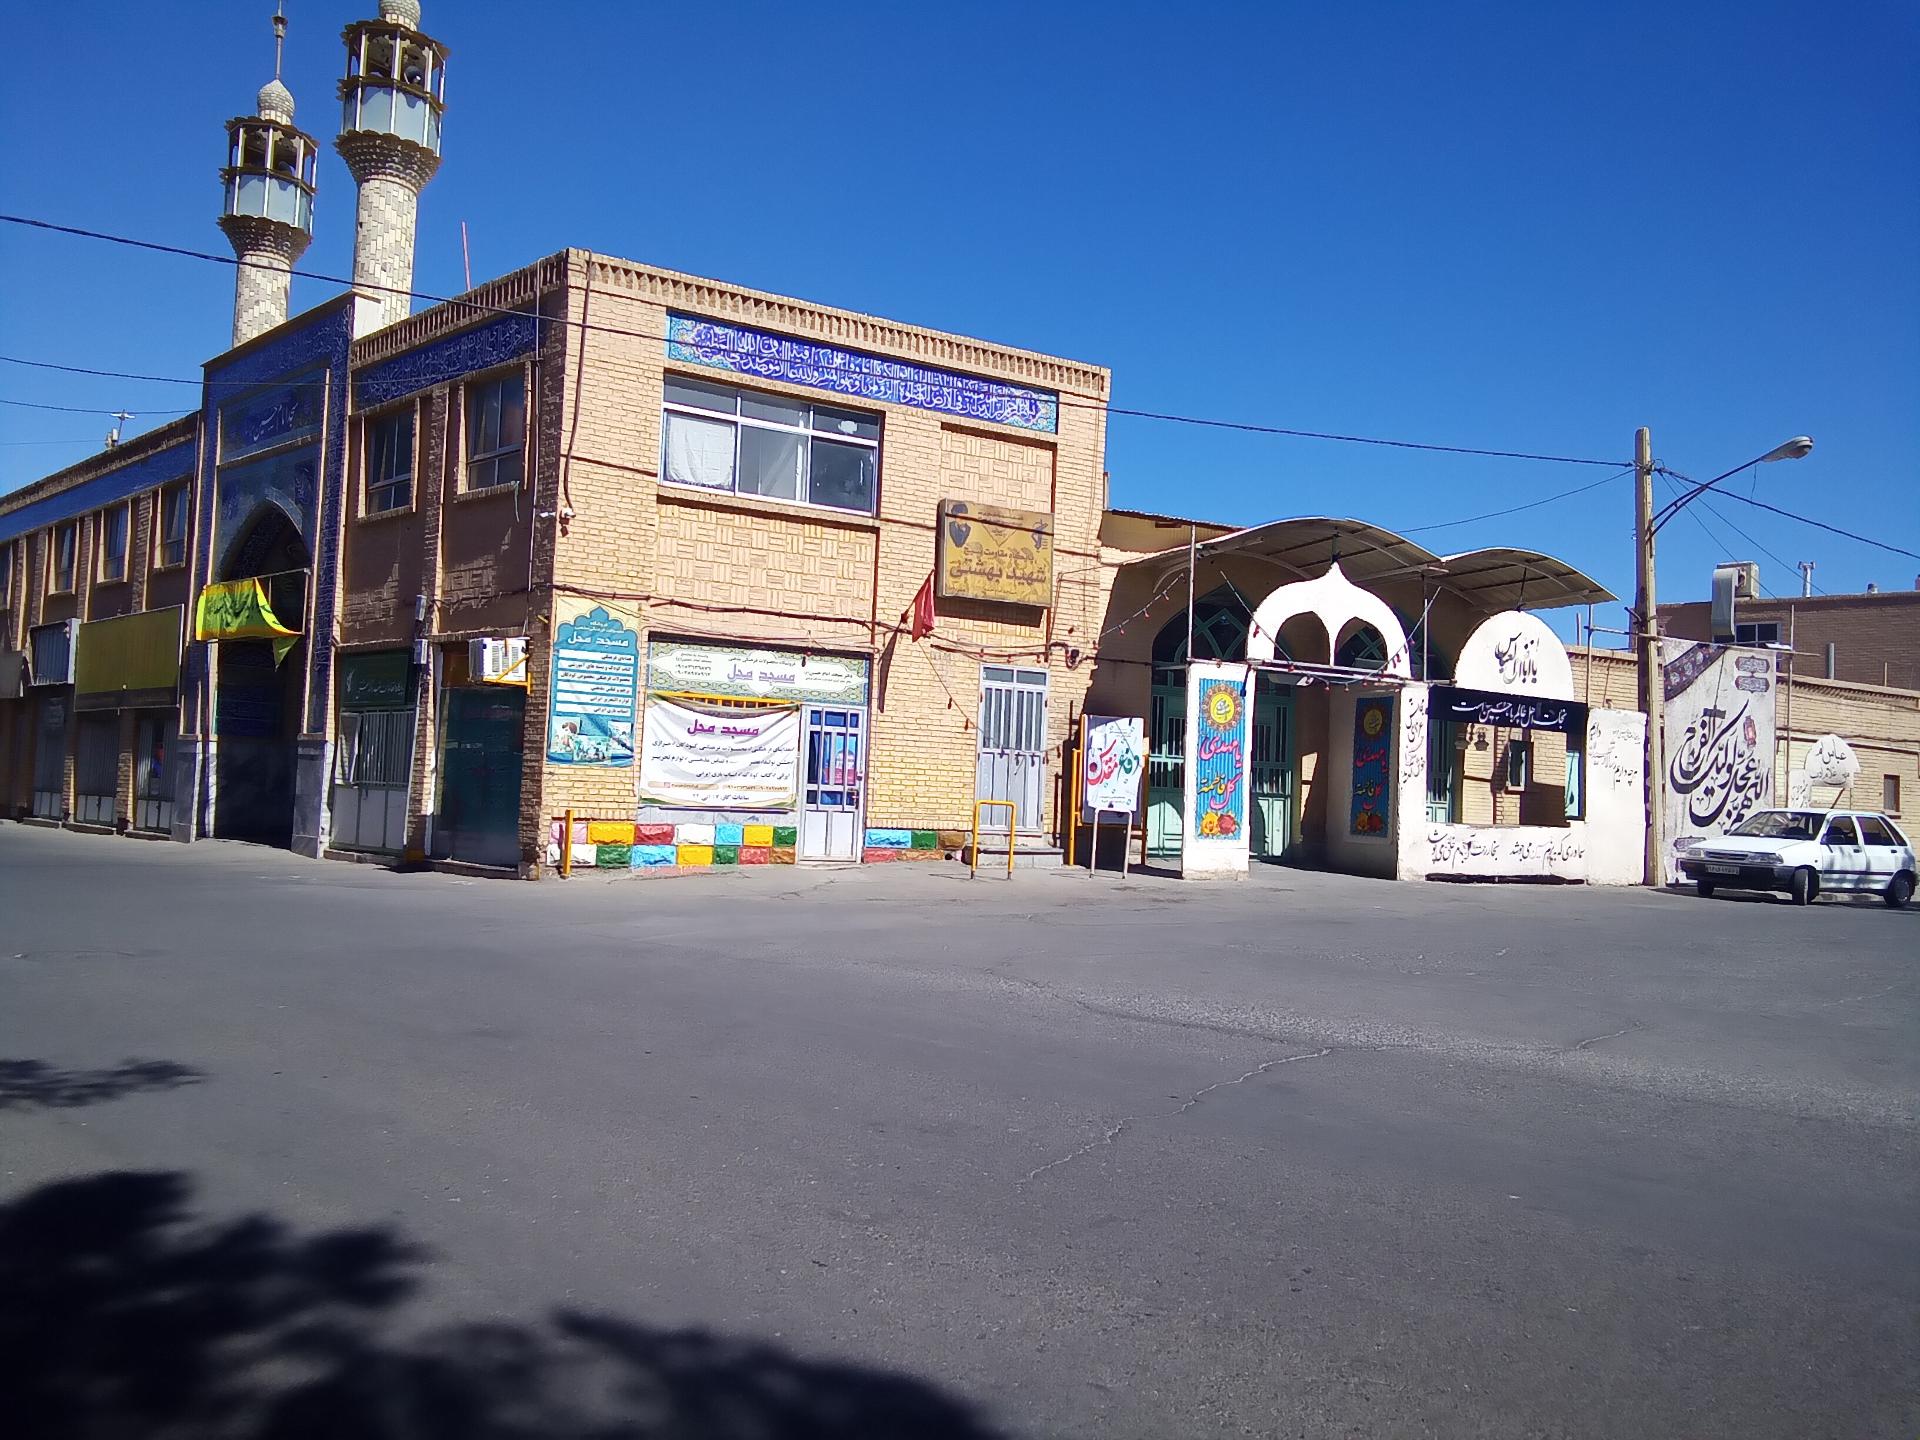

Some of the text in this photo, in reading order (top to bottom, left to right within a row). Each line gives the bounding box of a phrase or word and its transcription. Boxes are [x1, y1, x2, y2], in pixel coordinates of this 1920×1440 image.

[1006, 566, 1046, 585] شهید
[567, 631, 629, 649] مسجد محل
[727, 663, 796, 686] مسجد محل
[1532, 708, 1568, 729] نجات
[687, 719, 760, 740] مسجد محل
